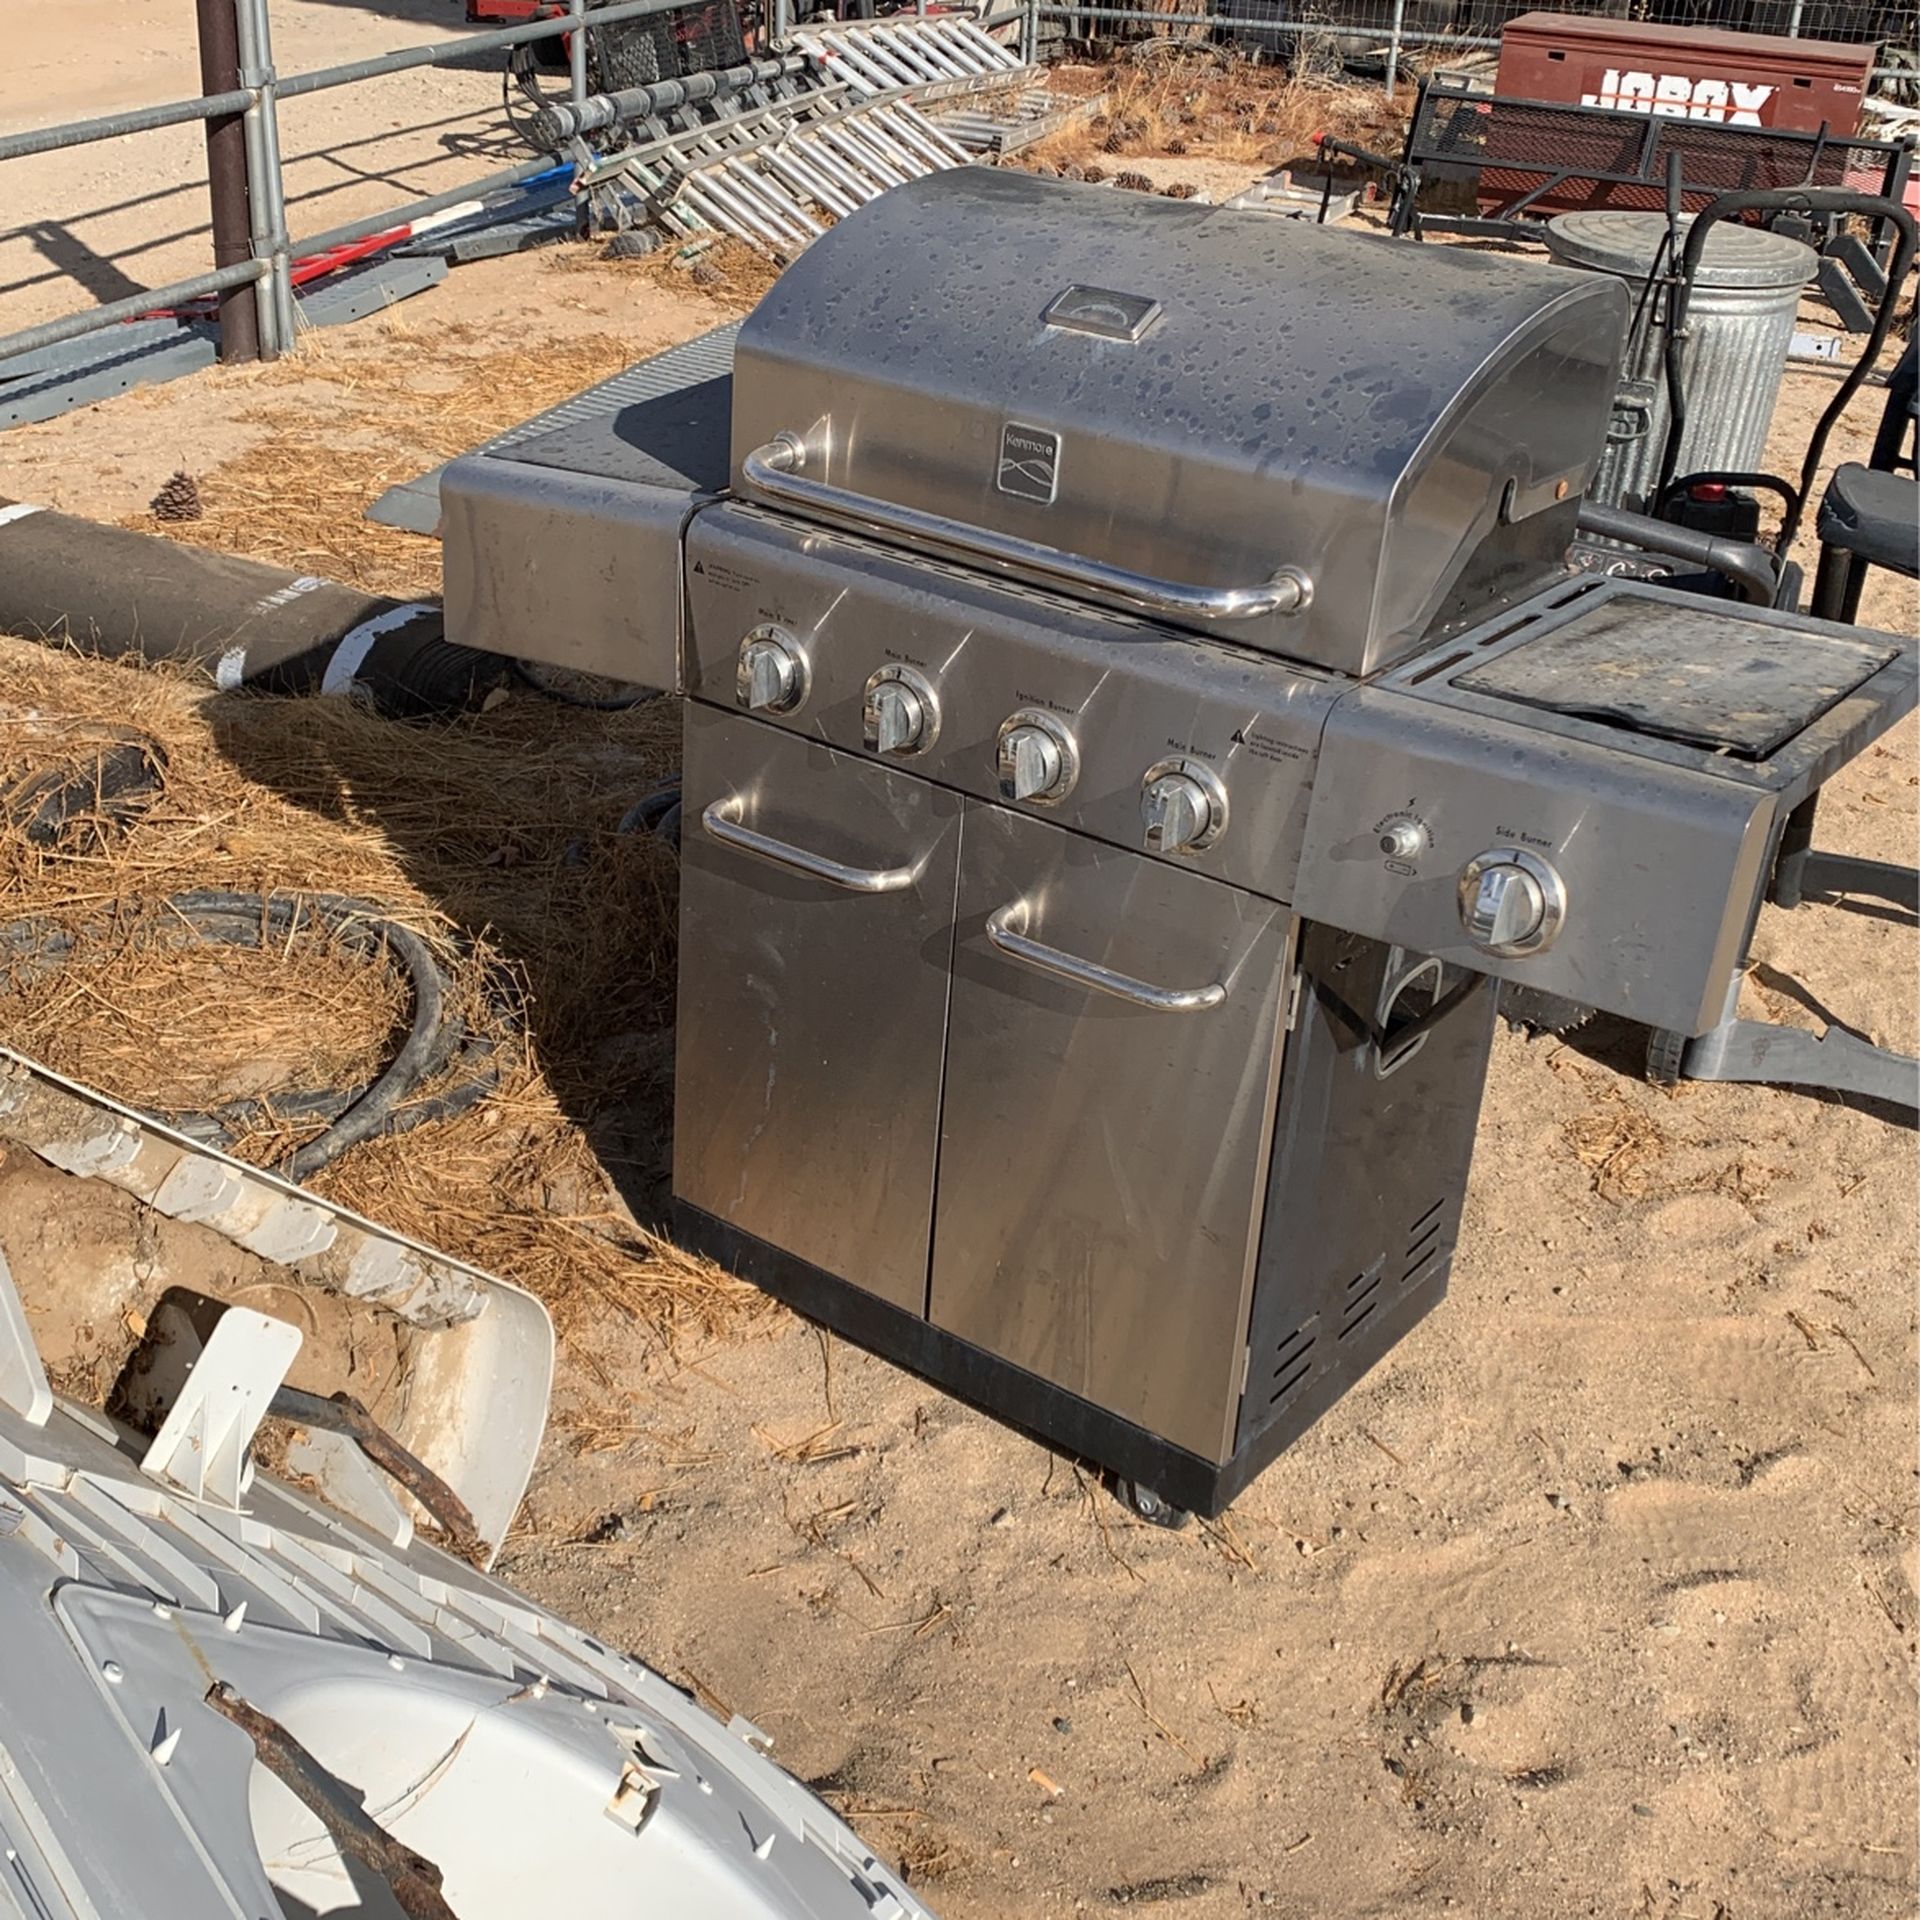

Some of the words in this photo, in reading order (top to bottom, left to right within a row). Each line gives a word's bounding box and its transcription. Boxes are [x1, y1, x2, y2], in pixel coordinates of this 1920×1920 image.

[1580, 68, 1777, 128] JOBOX
[1005, 433, 1054, 456] Kenmore
[884, 647, 902, 660] Main
[904, 654, 927, 667] Burner
[1015, 689, 1046, 706] Ignition
[1048, 700, 1075, 715] Burner
[1167, 737, 1186, 751] Main
[1190, 745, 1216, 760] Burner
[1372, 810, 1413, 834] Electronic
[1413, 813, 1435, 849] Ignition
[1495, 825, 1516, 839] Side
[1520, 832, 1553, 848] Burner
